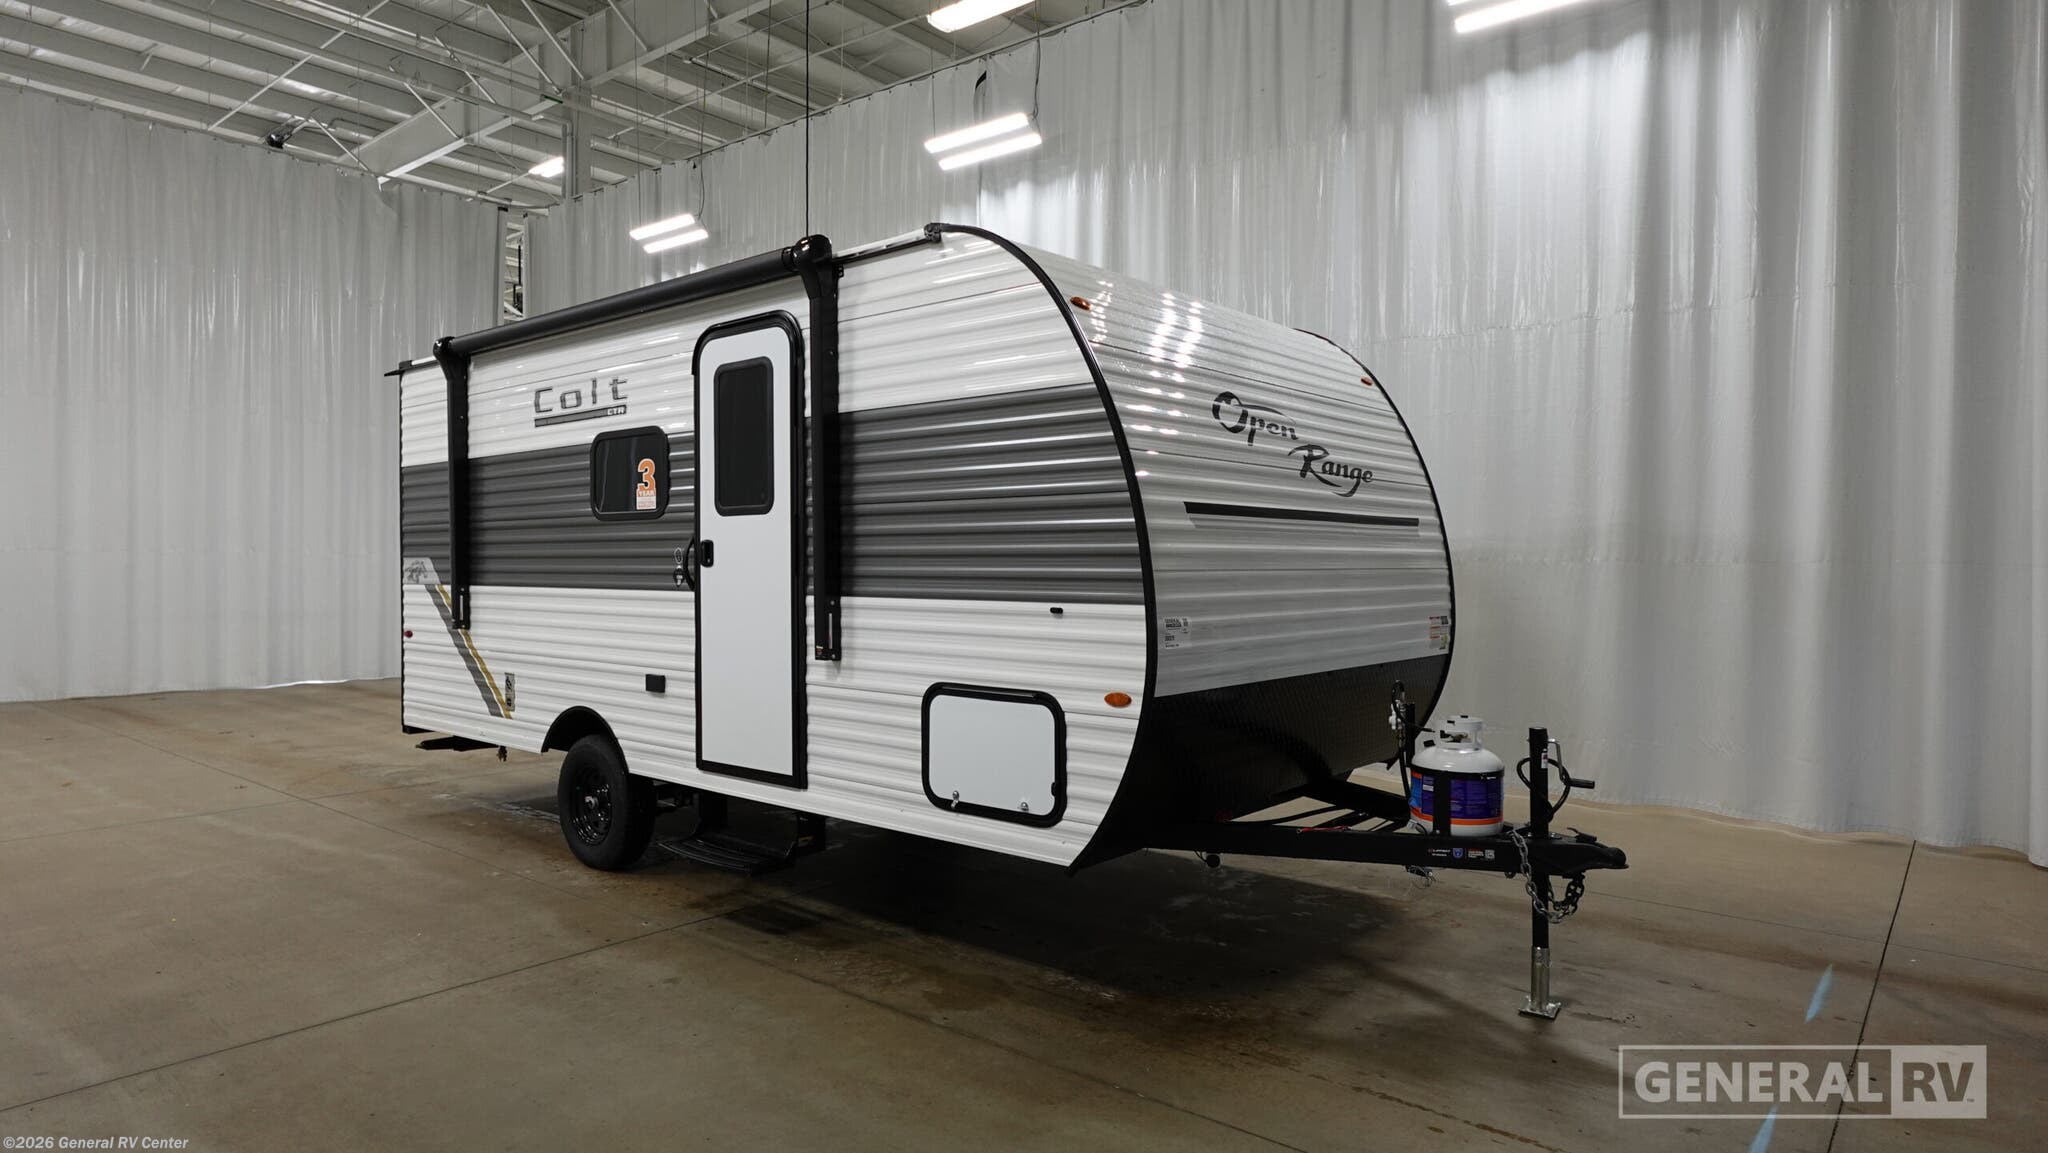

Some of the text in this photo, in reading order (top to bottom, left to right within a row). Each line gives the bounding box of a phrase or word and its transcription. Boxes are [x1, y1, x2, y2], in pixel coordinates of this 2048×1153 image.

[534, 377, 628, 414] Colt
[607, 406, 625, 417] CTR
[1212, 391, 1299, 447] Open
[638, 458, 656, 491] 3
[1287, 444, 1374, 498] Range
